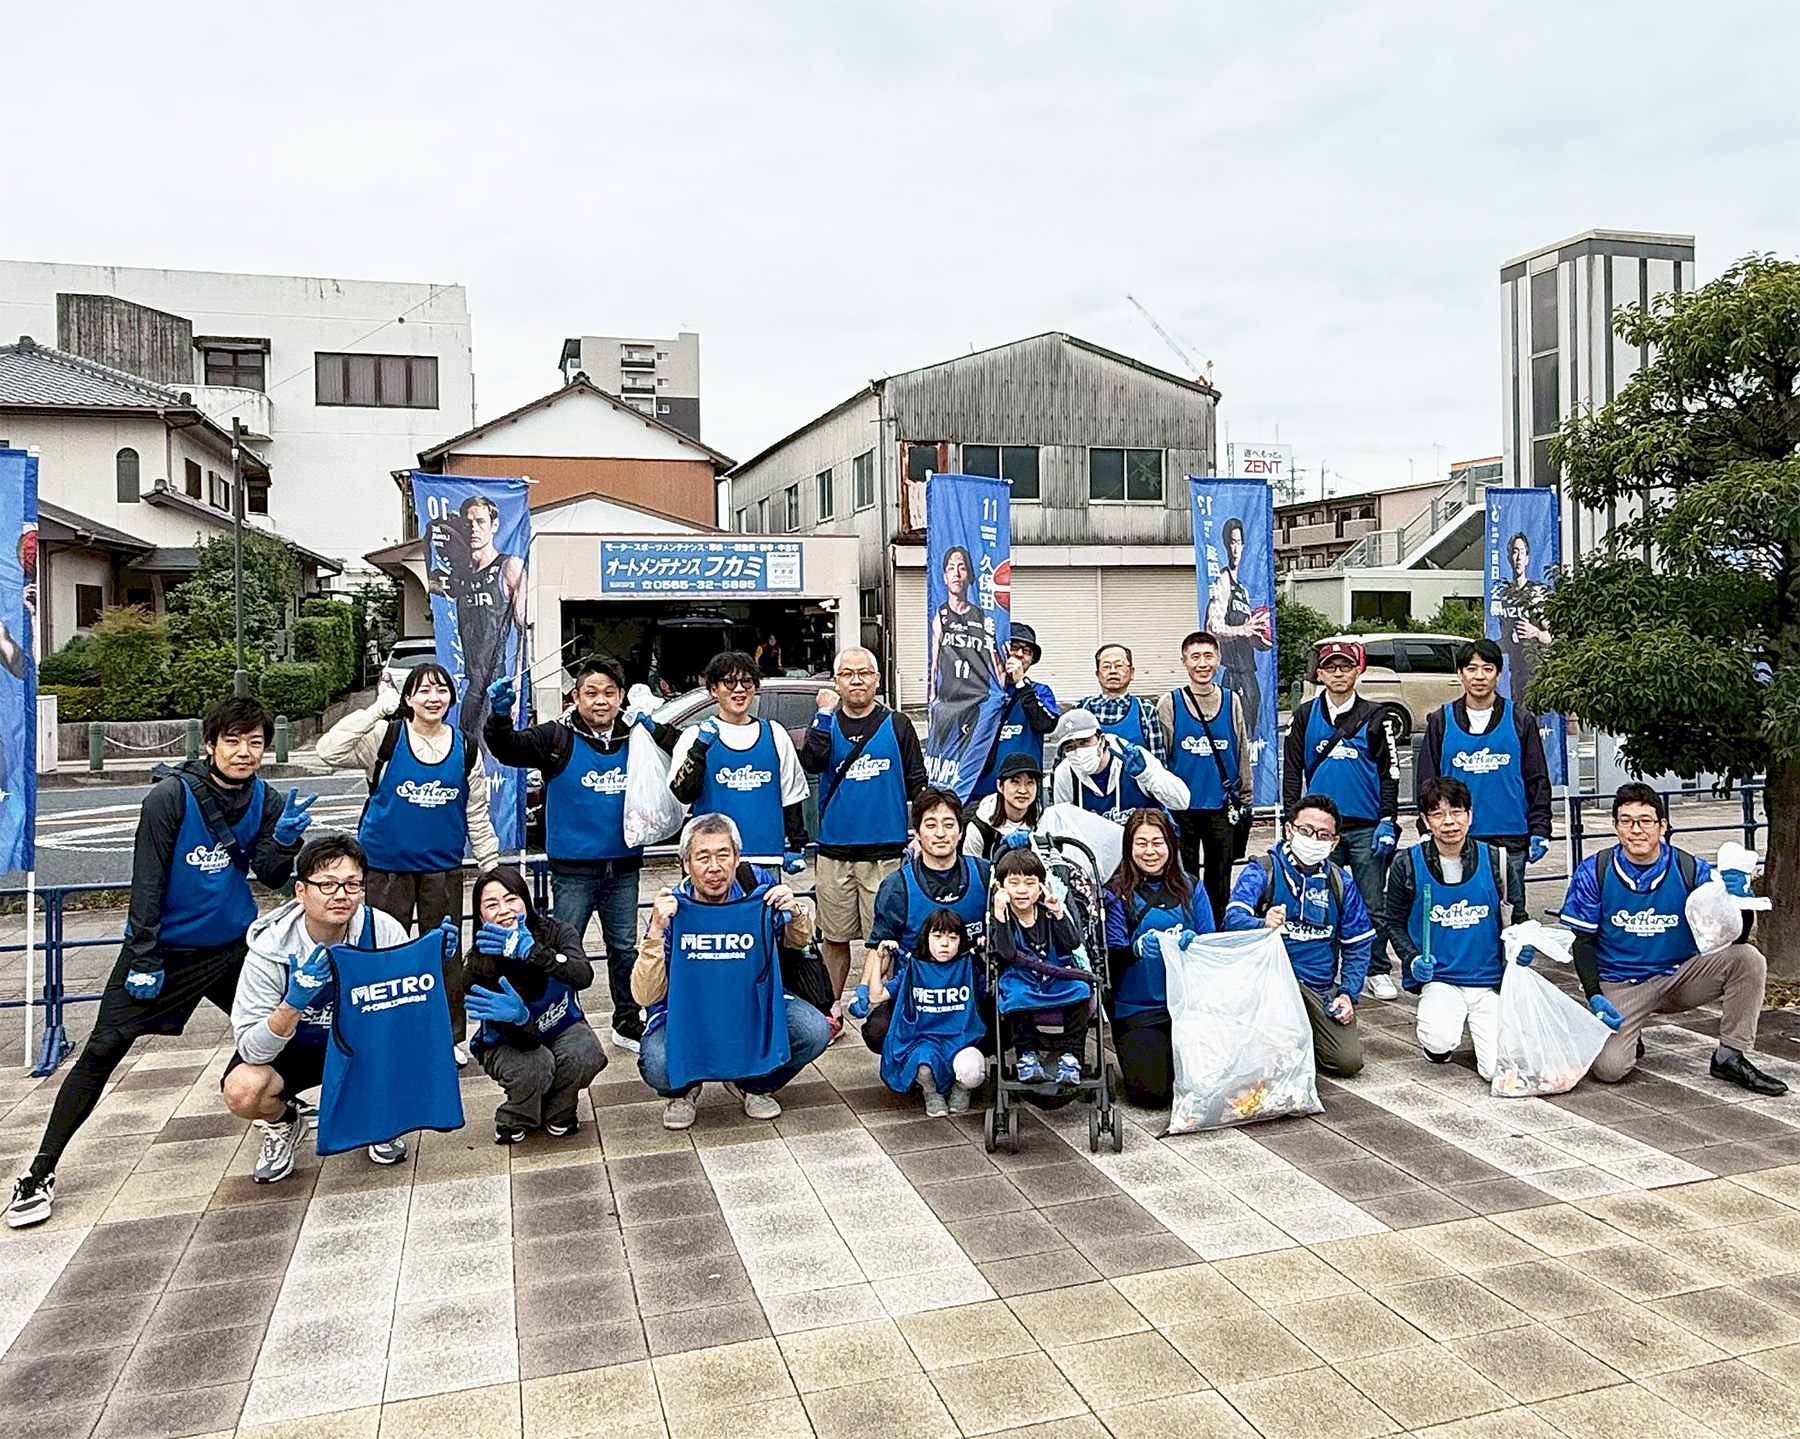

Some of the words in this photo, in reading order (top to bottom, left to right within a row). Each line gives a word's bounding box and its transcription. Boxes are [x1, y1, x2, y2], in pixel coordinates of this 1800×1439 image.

[1243, 459, 1283, 474] ZENT
[983, 497, 998, 523] 11
[605, 557, 702, 577] オートメンテナンス
[704, 555, 764, 578] フカミ
[954, 659, 971, 679] 11
[680, 933, 755, 950] METRO
[350, 973, 436, 1006] METRO
[912, 985, 970, 1004] METRO
